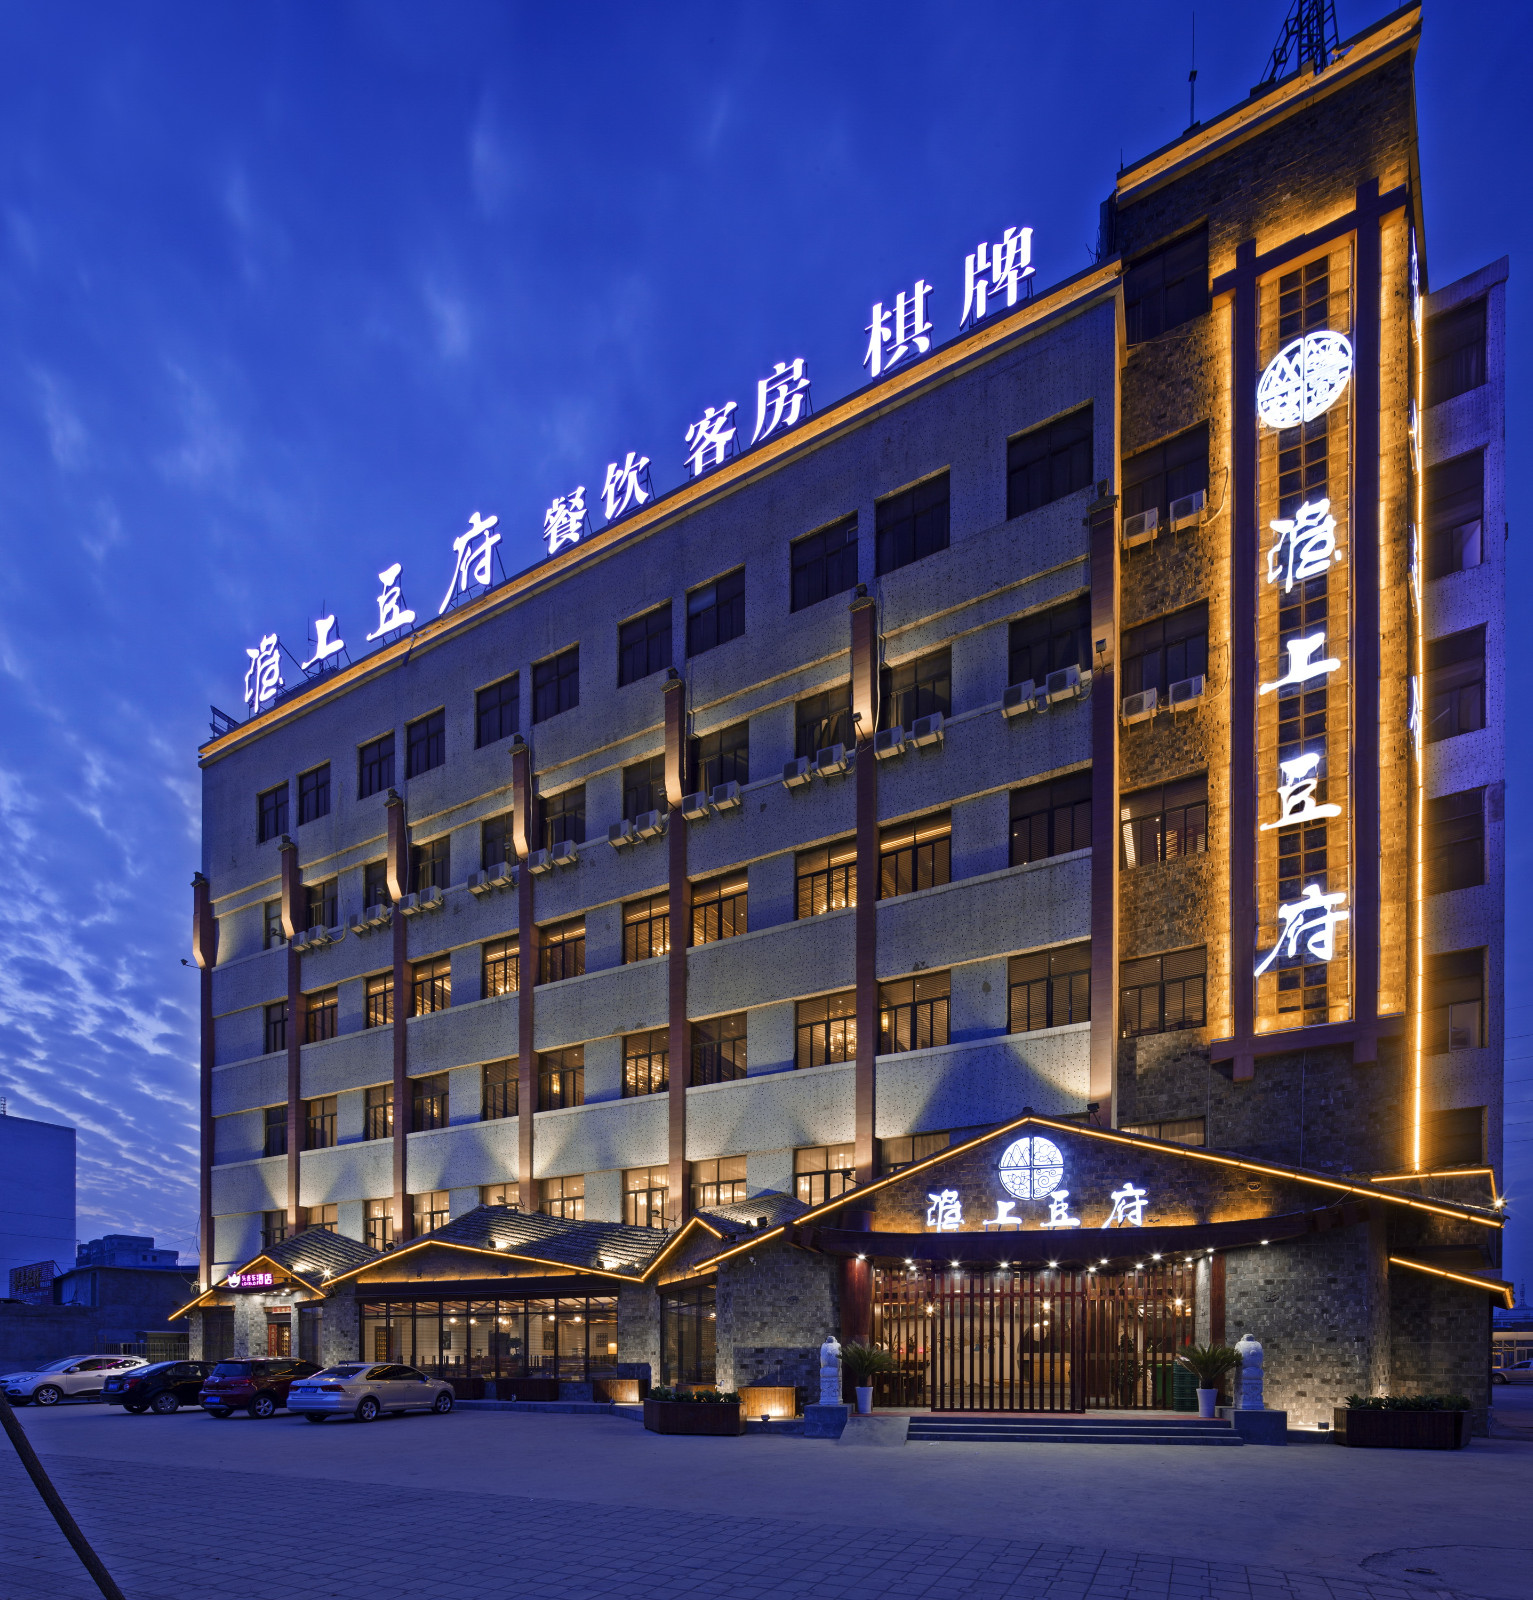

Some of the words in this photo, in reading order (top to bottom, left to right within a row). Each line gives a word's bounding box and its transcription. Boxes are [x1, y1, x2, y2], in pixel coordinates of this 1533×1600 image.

[543, 451, 650, 556] 餐饮
[684, 358, 810, 476] 客房
[864, 226, 1036, 377] 棋牌
